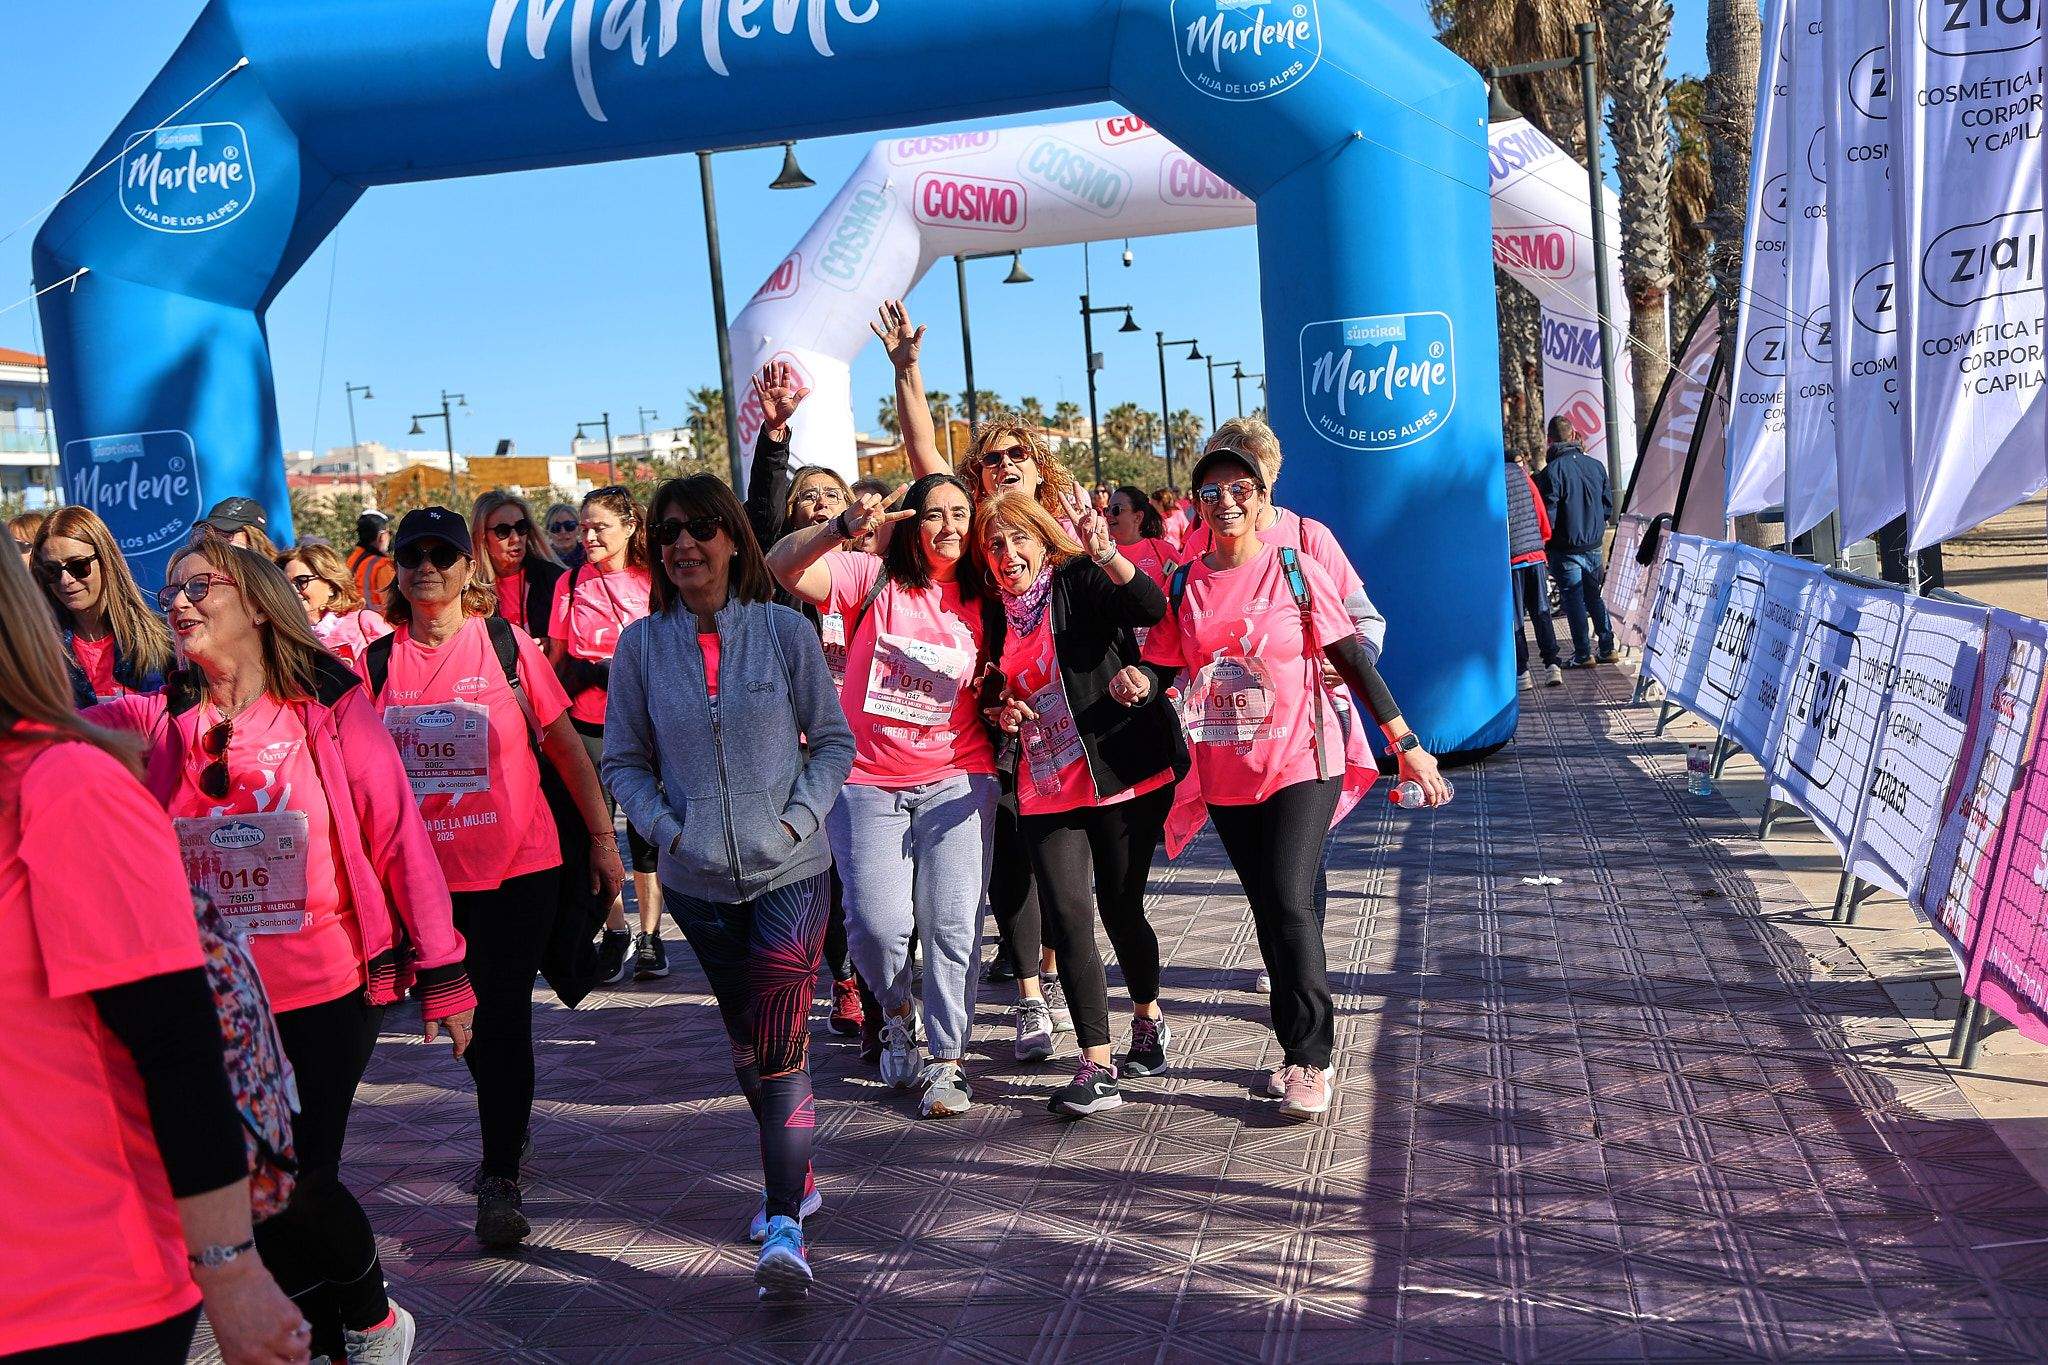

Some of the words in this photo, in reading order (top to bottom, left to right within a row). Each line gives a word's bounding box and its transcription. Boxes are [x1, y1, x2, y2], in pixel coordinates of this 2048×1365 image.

[1186, 7, 1311, 73] Marlene
[1197, 72, 1222, 91] HIJA
[1225, 83, 1240, 94] DE
[1243, 81, 1266, 94] LOS
[1269, 60, 1304, 88] ALPES
[1917, 70, 2034, 107] COSMÉTICA
[897, 130, 990, 159] COSMO
[1966, 136, 1980, 154] Y
[127, 148, 243, 206] Marlene
[1028, 141, 1122, 210] COSMO
[134, 203, 159, 222] HIJA
[161, 215, 178, 226] DE
[180, 215, 204, 226] LOS
[206, 199, 239, 222] ALPES
[923, 179, 1018, 225] COSMO
[820, 188, 888, 280] COSMO
[1492, 232, 1565, 271] OSMO
[1922, 321, 2029, 356] COSMÉTICA
[1311, 344, 1447, 416] Marlene
[1963, 380, 1972, 398] Y
[1320, 414, 1345, 437] HIJA
[1349, 429, 1367, 441] DE
[1370, 428, 1397, 442] LOS
[1401, 409, 1438, 438] ALPES
[73, 460, 190, 516] Marlene
[121, 536, 144, 549] LOS
[147, 517, 183, 544] ALPES
[821, 642, 847, 656] 016
[900, 675, 934, 693] 016
[905, 691, 920, 701] 1347
[1213, 693, 1247, 709] 016
[874, 703, 900, 715] OYSHO
[872, 723, 908, 739] CARRERA
[1043, 716, 1069, 739] 016
[1885, 710, 1893, 734] Y
[416, 742, 456, 758] 016
[424, 761, 444, 769] 8002
[434, 819, 447, 831] DE
[449, 817, 461, 830] LA
[462, 811, 498, 827] MUJER
[213, 833, 261, 844] ASTURIANA
[436, 831, 455, 842] 2025
[219, 867, 270, 890] 016
[220, 906, 229, 914] DE
[230, 905, 239, 914] LA
[239, 904, 262, 914] MUJER
[266, 902, 296, 911] VALENCIA
[229, 893, 255, 904] 7969
[260, 918, 299, 928] Santander
